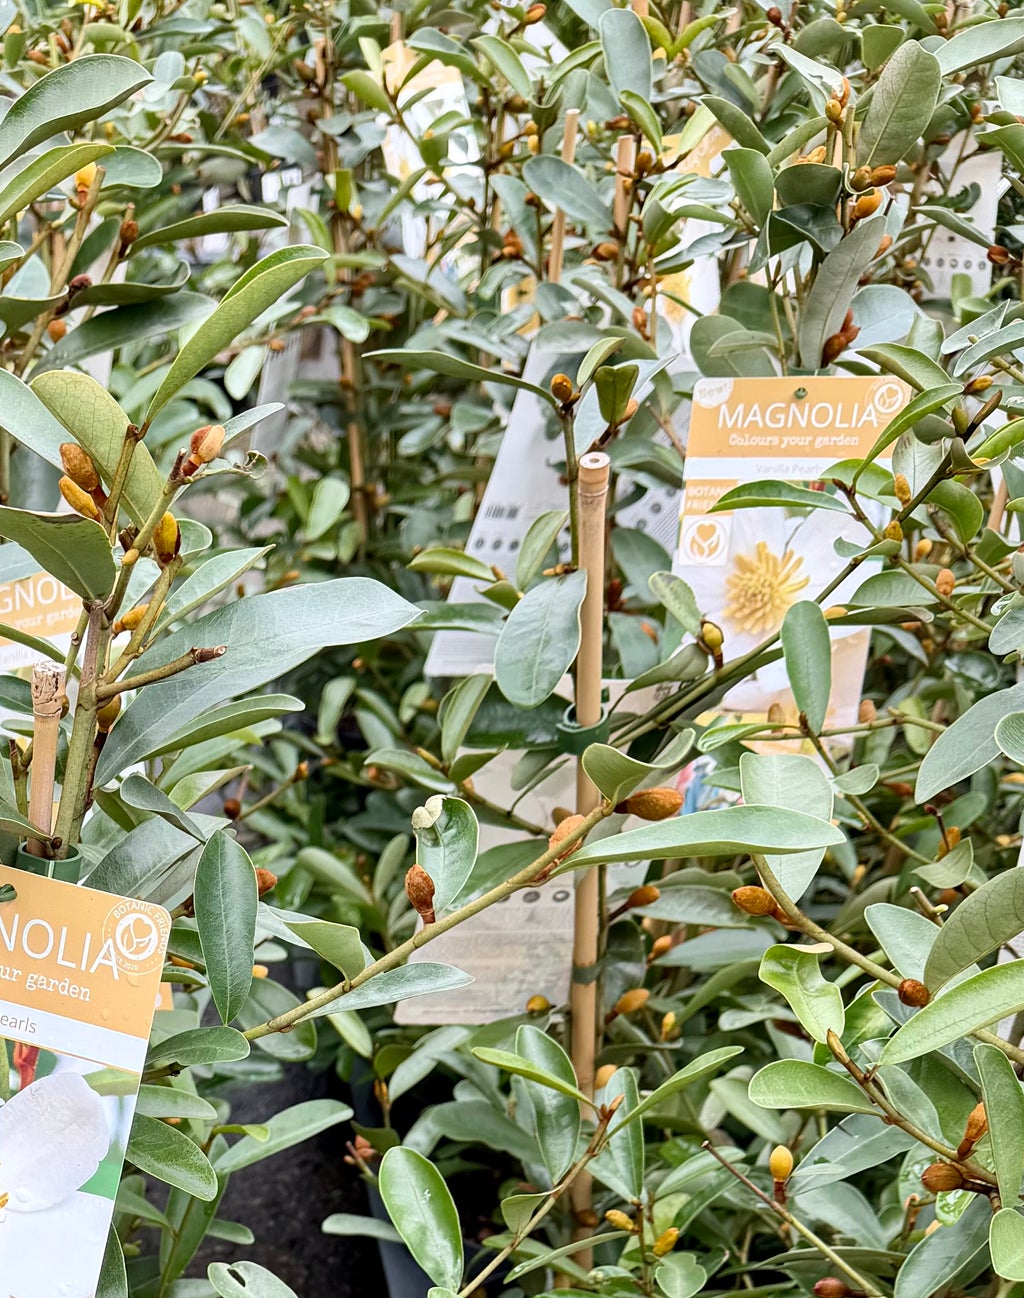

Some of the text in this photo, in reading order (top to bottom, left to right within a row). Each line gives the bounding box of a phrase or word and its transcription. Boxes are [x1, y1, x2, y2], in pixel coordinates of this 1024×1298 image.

[717, 402, 878, 429] MAGNOLIA
[728, 433, 859, 448] Colours your garden
[112, 901, 168, 957] BOTANIC FRIENDS
[26, 973, 92, 1003] garden
